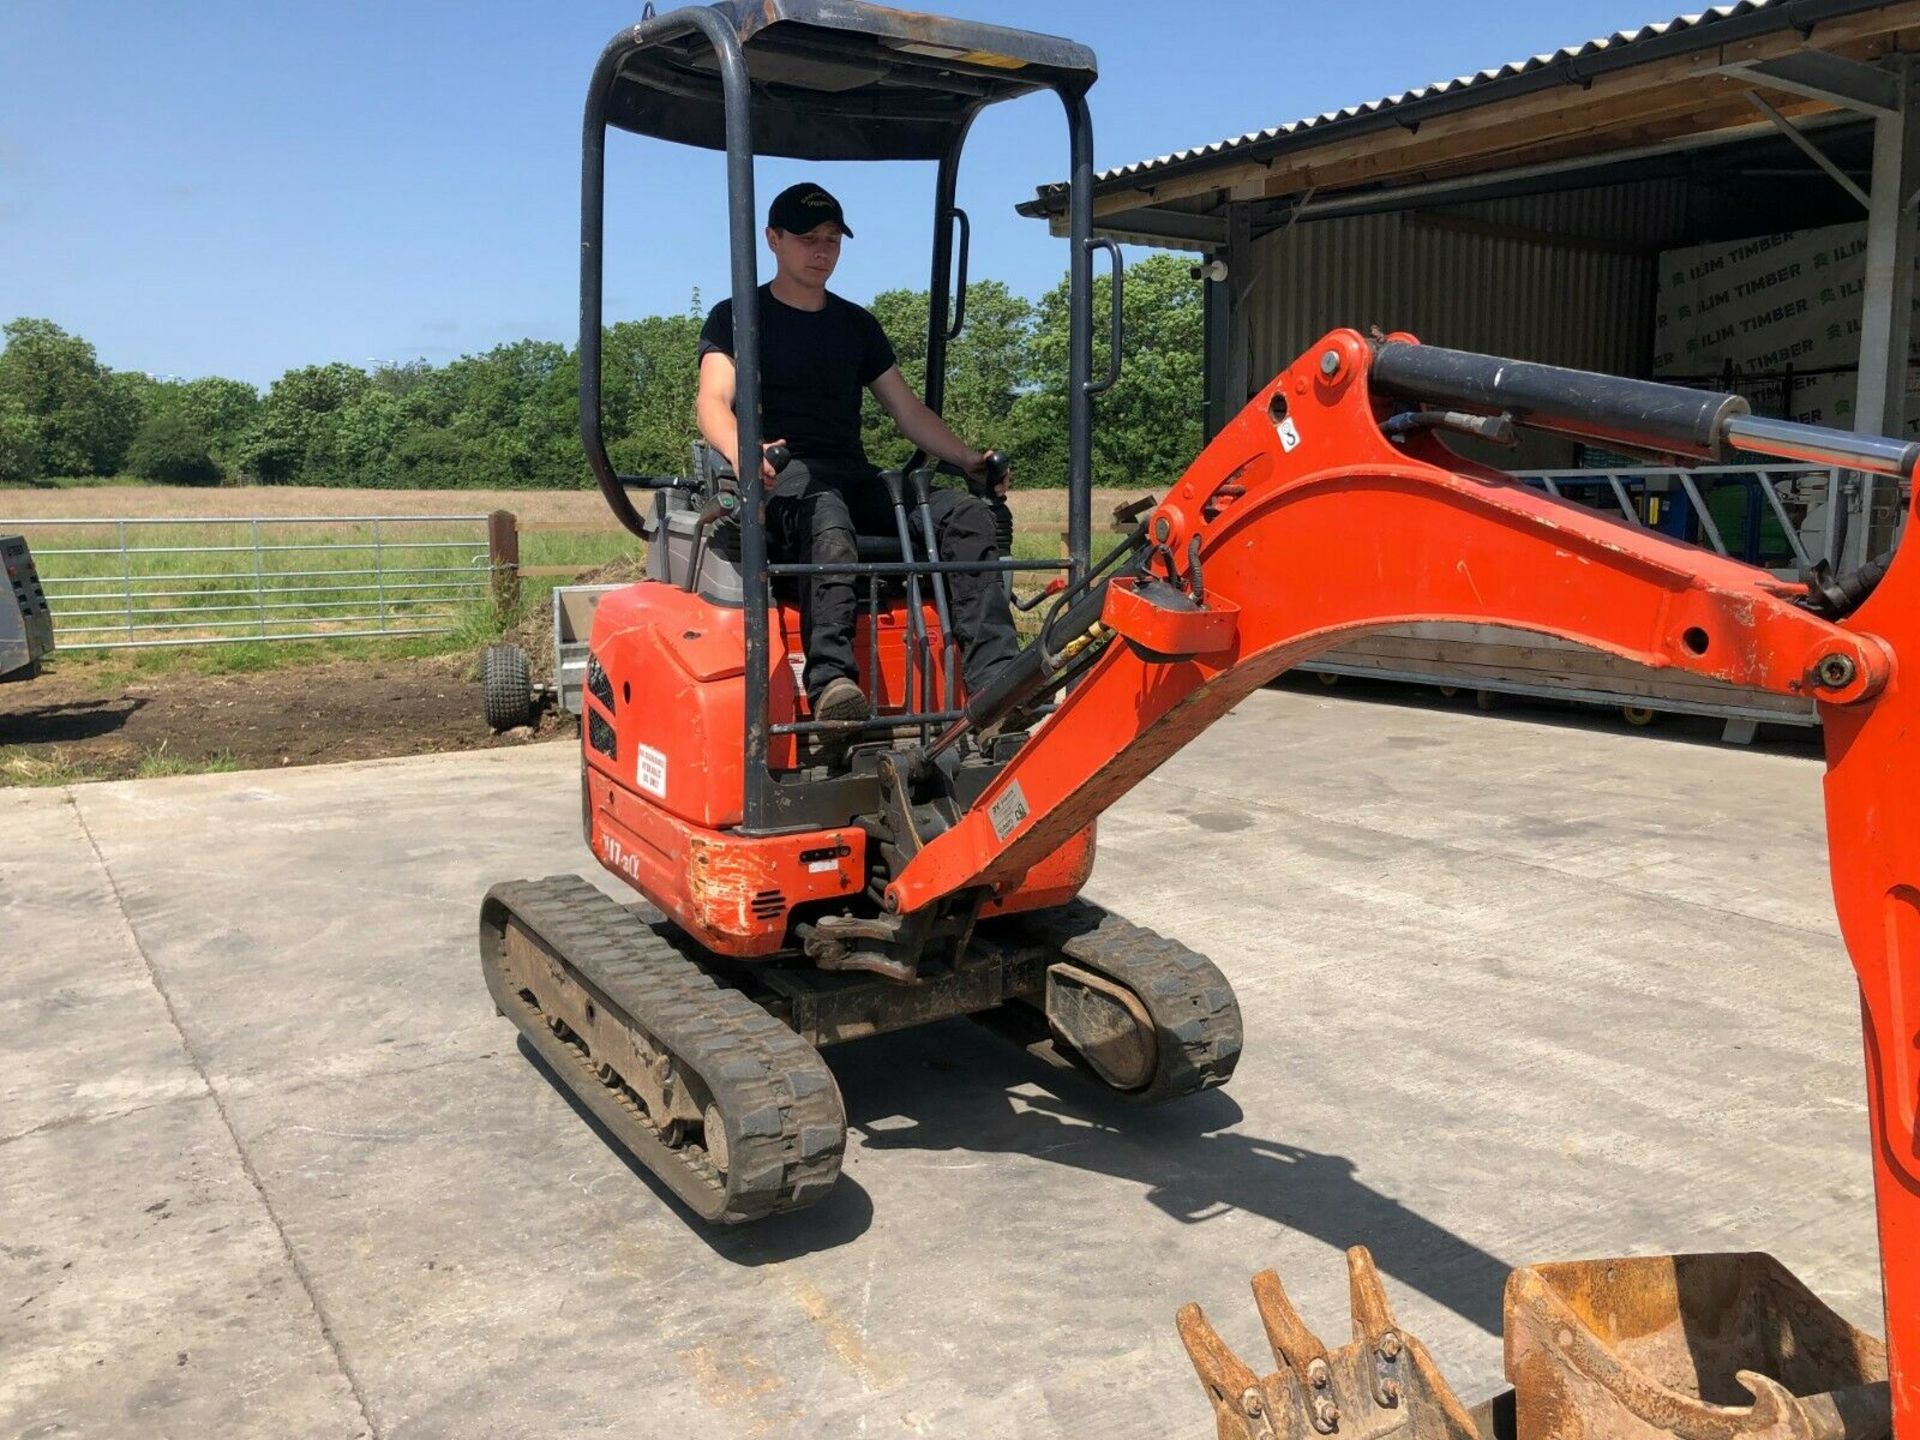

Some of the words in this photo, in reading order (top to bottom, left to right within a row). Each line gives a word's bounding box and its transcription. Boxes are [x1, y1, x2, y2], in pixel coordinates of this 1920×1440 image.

[1689, 256, 1725, 281] ILIM
[1728, 232, 1793, 264] TIMBER
[1698, 288, 1729, 314] ILIM
[1735, 264, 1800, 298] TIMBER
[1840, 276, 1865, 298] ILI
[1702, 323, 1735, 348] ILIM
[1739, 298, 1808, 333] TIMBER
[1746, 338, 1814, 372] TIMBER
